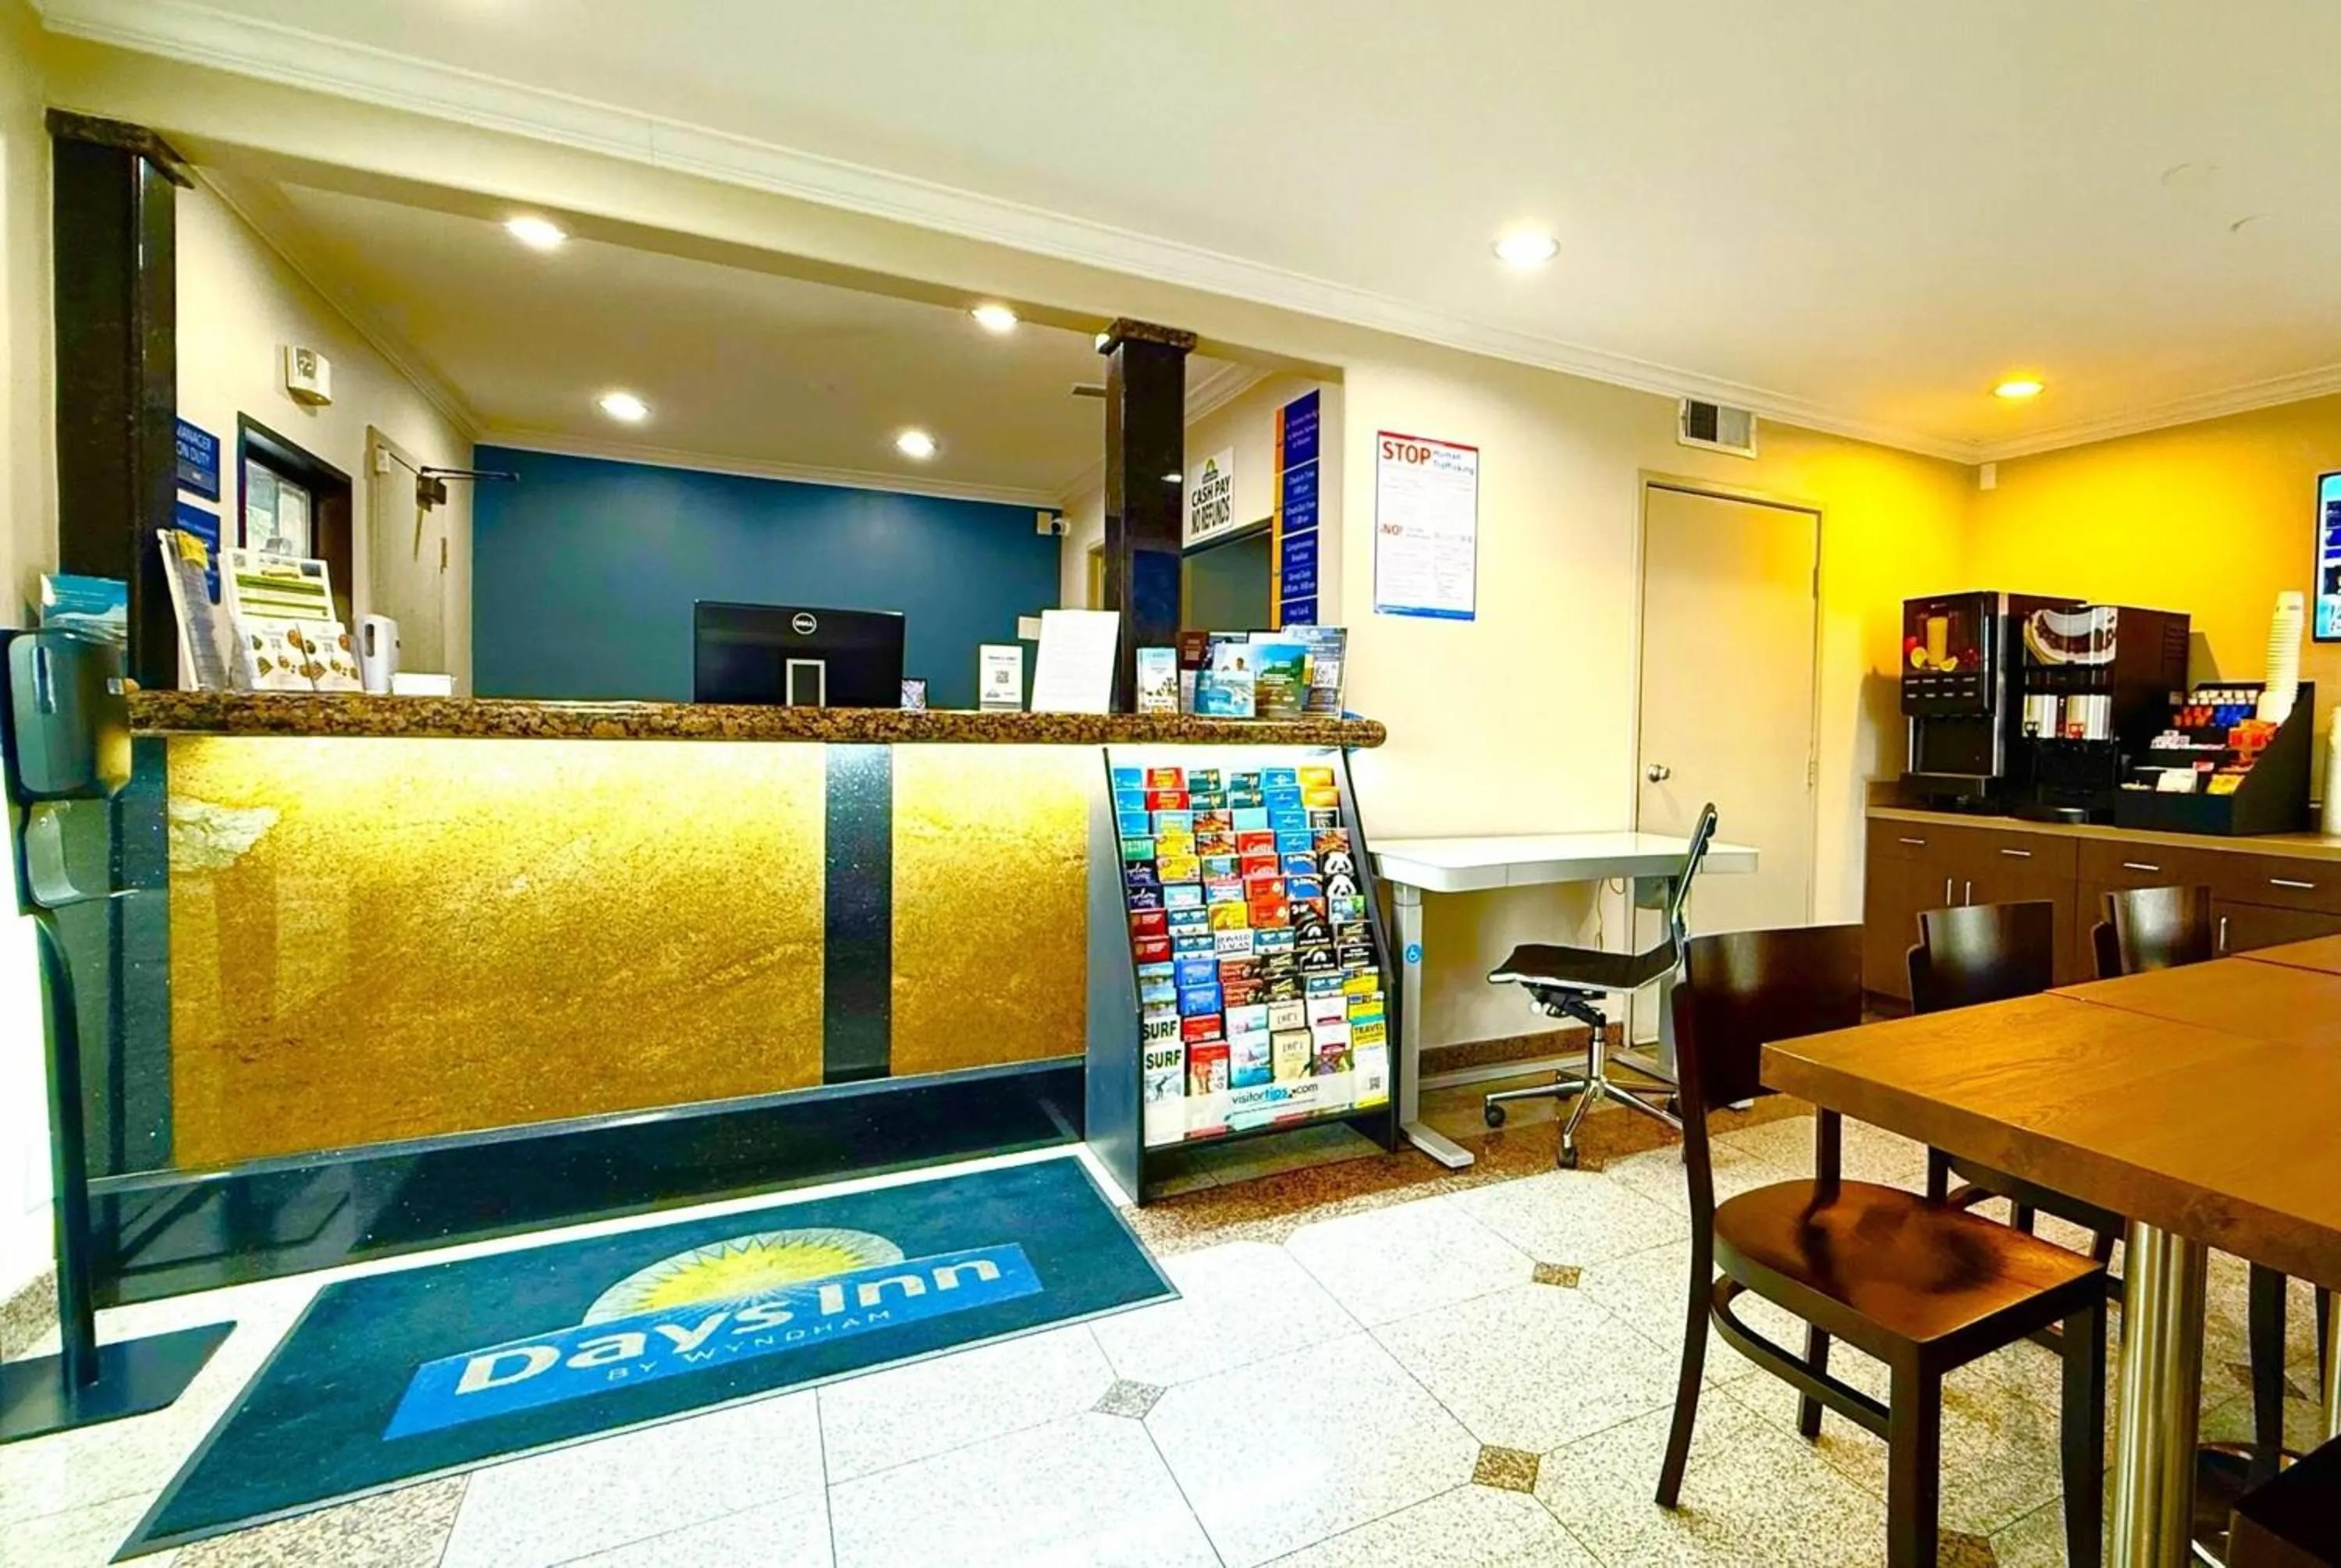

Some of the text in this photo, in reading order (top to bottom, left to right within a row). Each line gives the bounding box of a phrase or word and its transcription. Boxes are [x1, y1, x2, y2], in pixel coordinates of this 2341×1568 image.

[190, 447, 211, 468] DUTY
[1382, 441, 1431, 465] STOP
[1192, 483, 1214, 508] CASH
[1214, 474, 1231, 498] PAY
[1191, 494, 1231, 535] NO REFUNDS
[1143, 1020, 1178, 1041] SURF
[1355, 1023, 1384, 1034] TRAVEL
[1146, 1049, 1182, 1070] SURF
[1232, 1082, 1319, 1105] visitortips.com
[455, 1259, 1001, 1395] Days Inn
[607, 1309, 892, 1382] BY WYNDHAM
